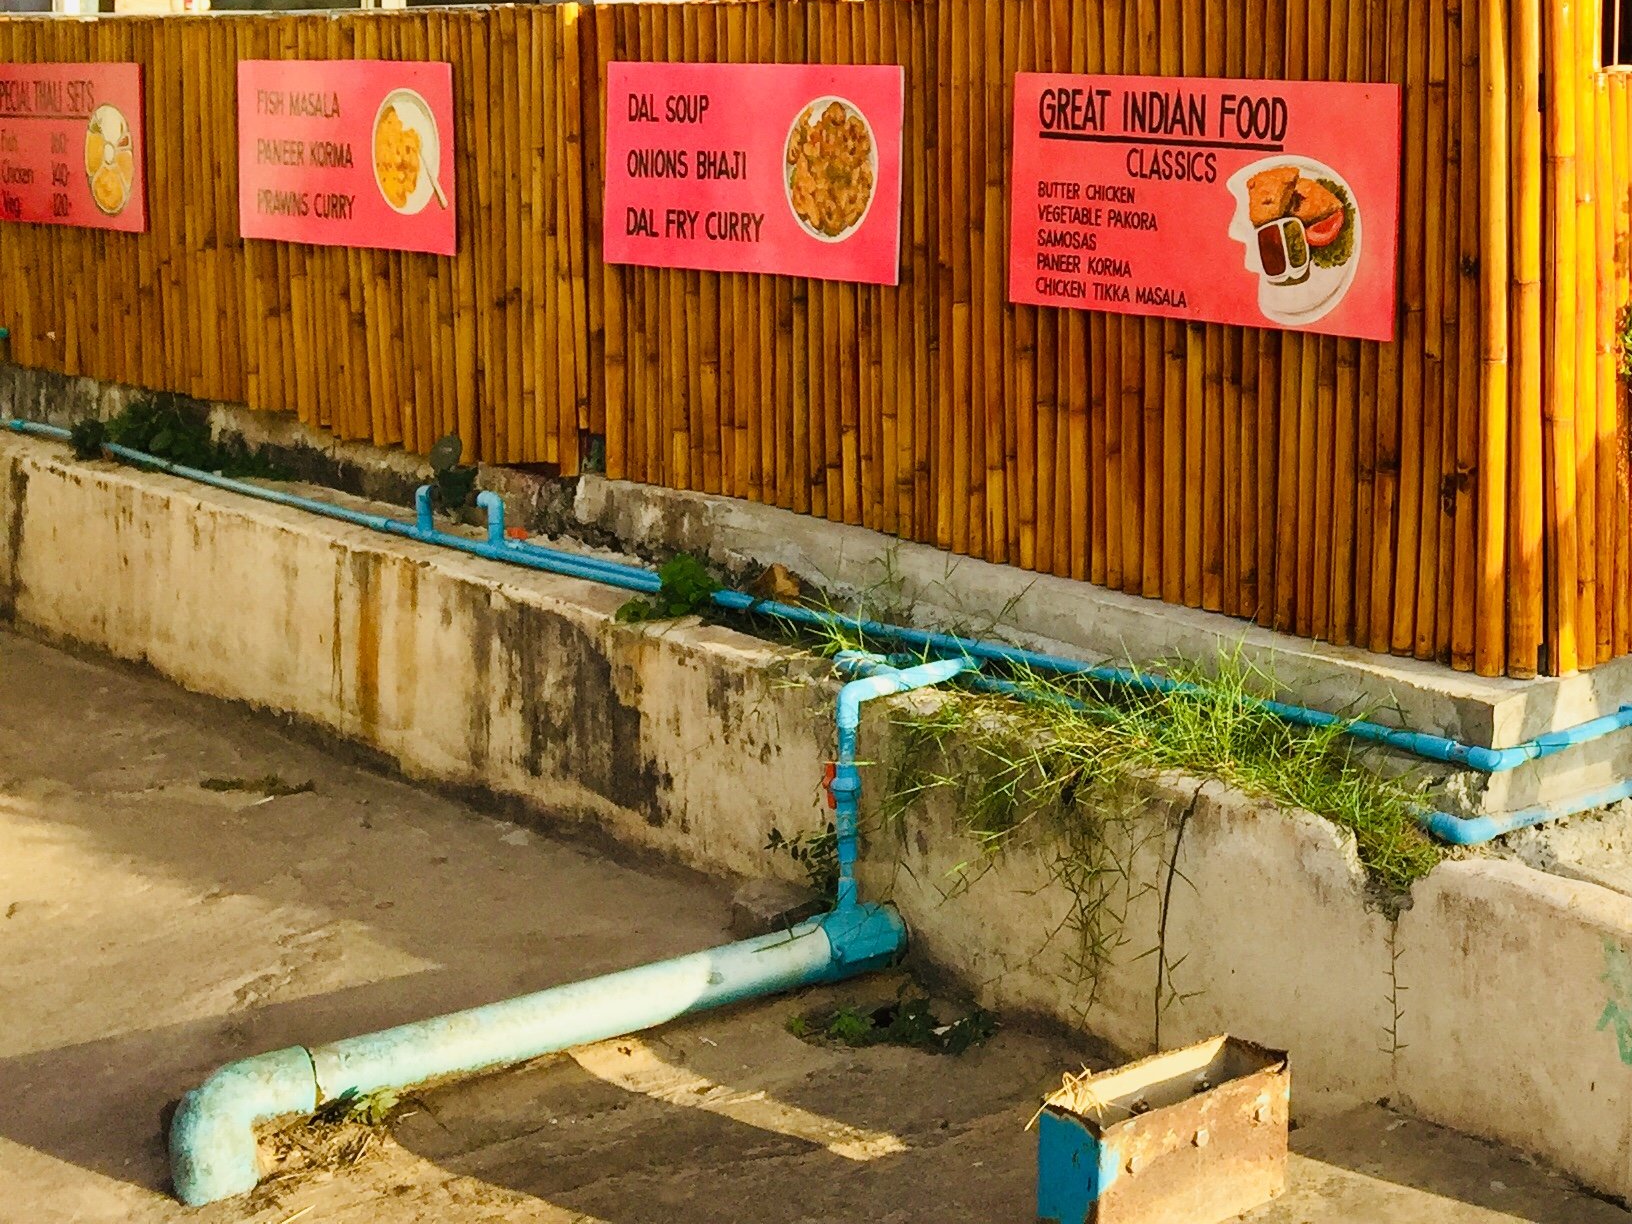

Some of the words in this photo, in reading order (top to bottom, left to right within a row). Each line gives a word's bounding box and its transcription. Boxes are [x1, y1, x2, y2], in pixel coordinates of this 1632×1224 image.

[66, 80, 95, 113] SETS
[256, 89, 285, 116] FISH
[289, 90, 341, 119] MASALA
[628, 93, 659, 123] DAL
[665, 94, 710, 124] SOUP
[1039, 84, 1112, 132] GREAT
[1122, 88, 1206, 138] INDIAN
[1219, 94, 1288, 142] FOOD
[257, 138, 305, 166] PANEER
[310, 140, 354, 169] KORMA
[627, 149, 689, 179] ONIONS
[696, 150, 747, 181] BHAJI
[1126, 148, 1218, 183] CLASSICS
[257, 188, 309, 217] PRAWNS
[313, 192, 356, 221] CURRY
[1037, 180, 1081, 201] BUTTER
[1085, 182, 1136, 204] CHICKEN
[626, 206, 660, 237] DAL
[665, 208, 700, 240] FRY
[704, 210, 766, 243] CURRY
[1037, 203, 1102, 227] VEGETABLE
[1107, 208, 1158, 232] PAKORA
[1037, 228, 1097, 251] SAMOSAS
[1036, 252, 1081, 274] PANEER
[1087, 255, 1132, 278] KORMA
[1035, 276, 1086, 299] CHICKEN
[1092, 281, 1131, 302] TIKKA
[1135, 285, 1188, 308] MASALA
